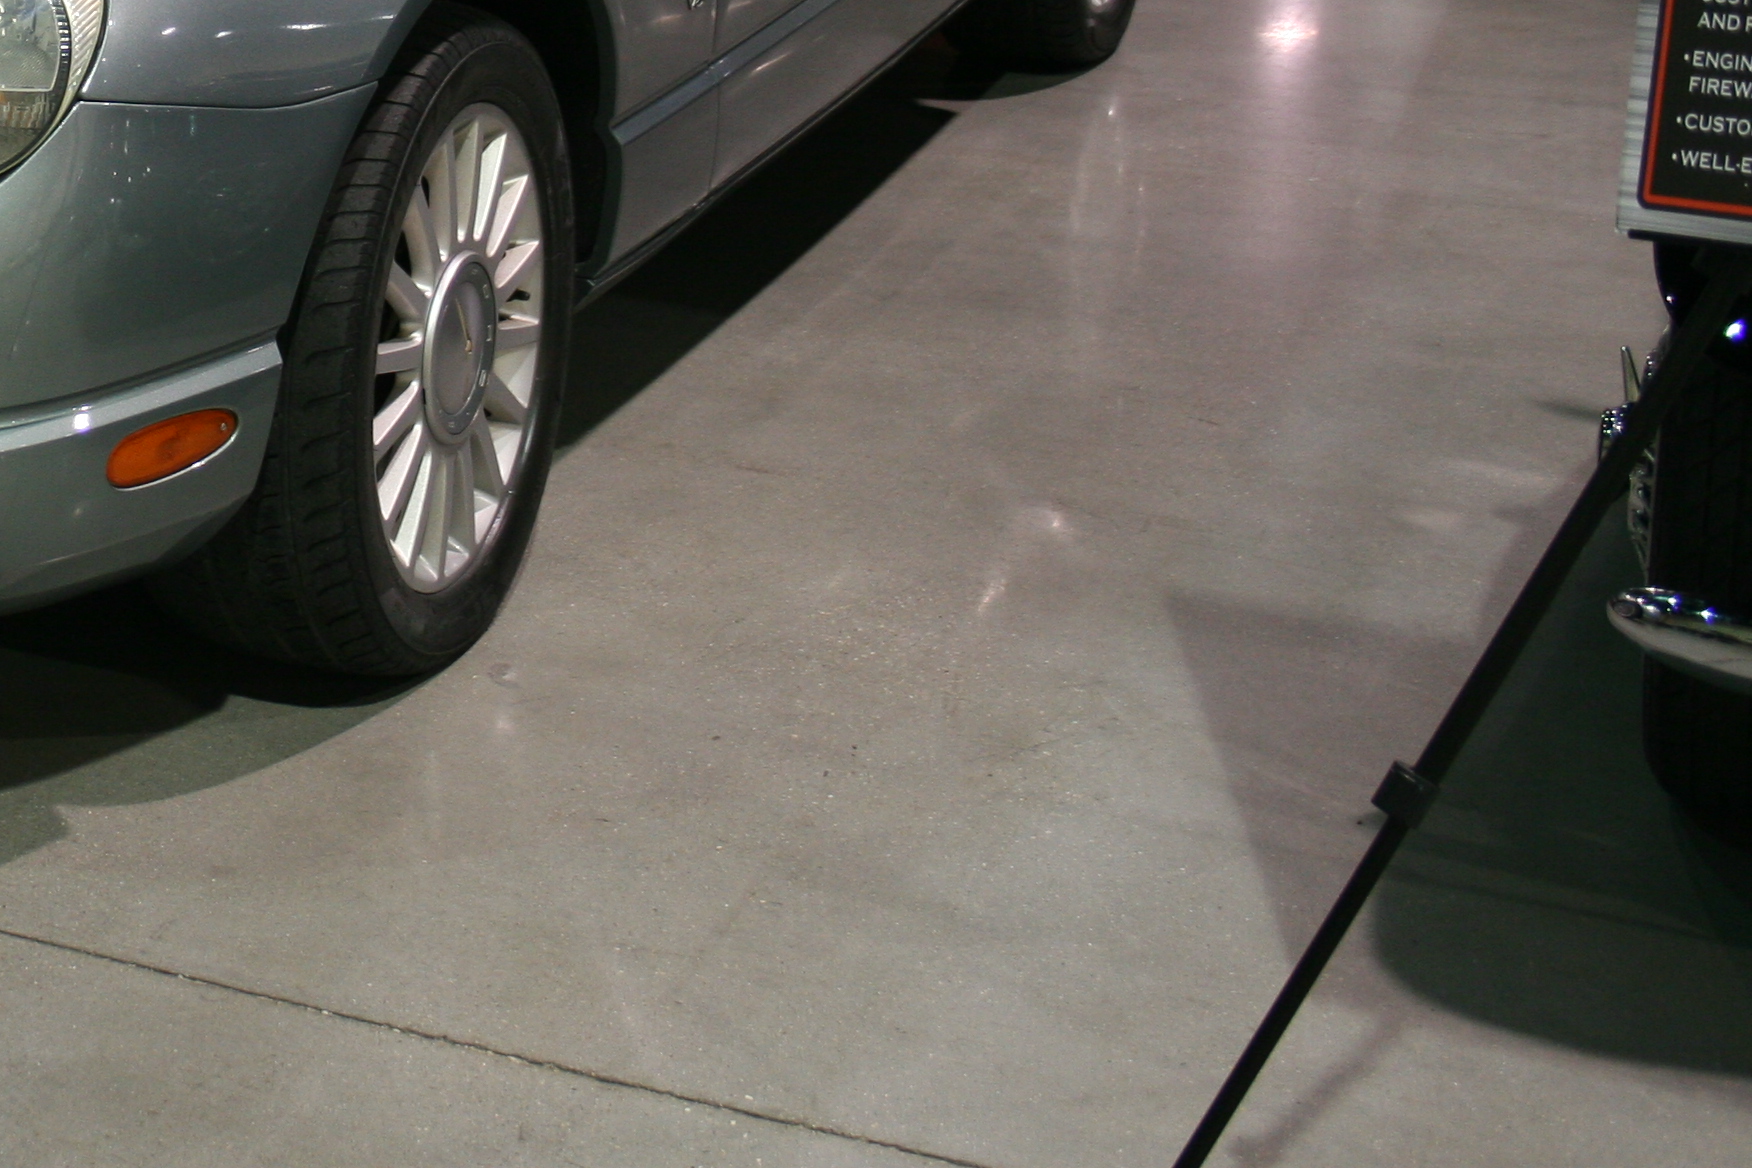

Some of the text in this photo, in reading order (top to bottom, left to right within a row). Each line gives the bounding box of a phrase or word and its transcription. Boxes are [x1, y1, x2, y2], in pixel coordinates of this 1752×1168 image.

[1697, 12, 1740, 31] AND
[1692, 50, 1752, 72] ENGIN
[1689, 76, 1752, 99] FIREW
[1684, 113, 1752, 136] CUSTO
